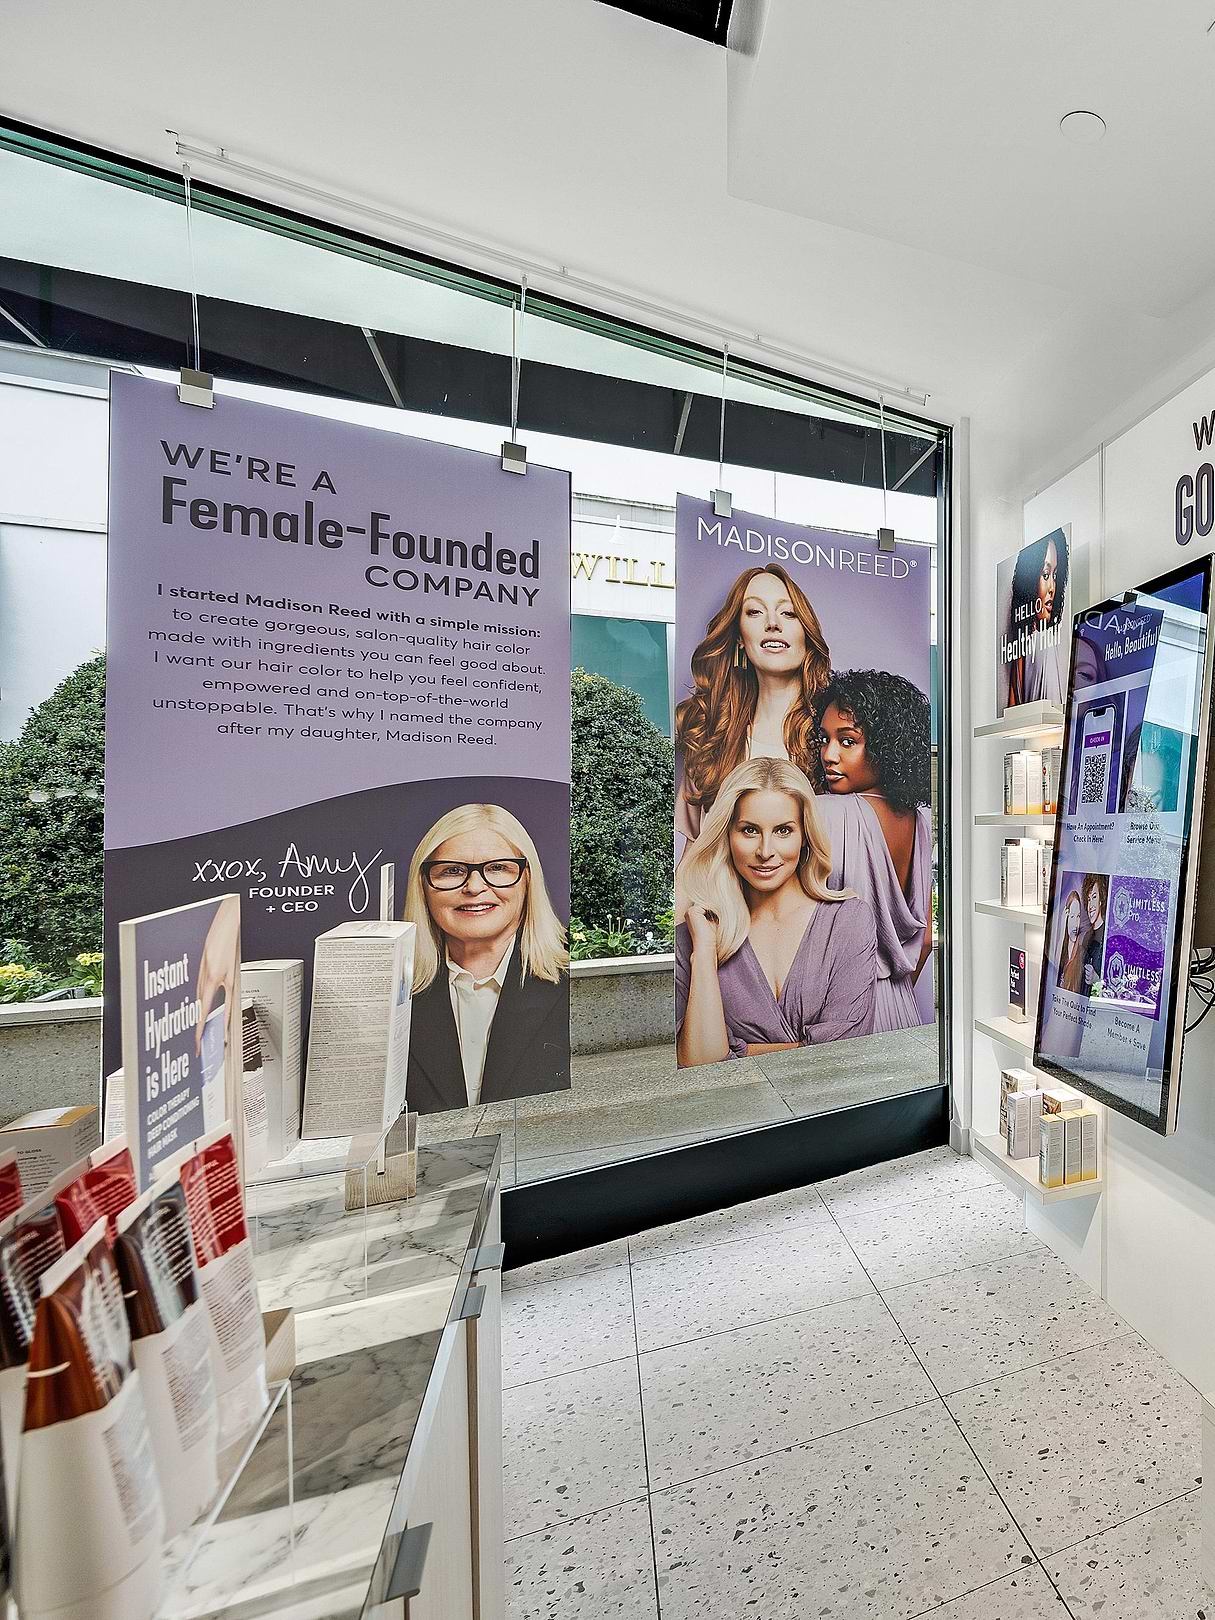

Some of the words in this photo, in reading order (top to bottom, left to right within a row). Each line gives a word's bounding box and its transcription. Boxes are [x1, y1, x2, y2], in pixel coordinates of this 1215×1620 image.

[159, 439, 297, 488] WE'RE
[310, 470, 338, 496] A
[161, 475, 540, 580] Female-Founded
[364, 565, 541, 608] COMPANY
[157, 582, 163, 596] I
[169, 586, 240, 605] started
[245, 593, 323, 614] Madison
[328, 603, 371, 620] Reed
[375, 610, 411, 624] with
[415, 616, 426, 626] a
[429, 616, 480, 632] simple
[483, 623, 541, 639] mission:
[171, 607, 193, 621] to
[198, 613, 259, 628] create
[264, 620, 350, 639] gorgeous,
[354, 628, 459, 651] salon-quality
[462, 637, 492, 652] hair
[494, 642, 531, 656] color
[1014, 597, 1044, 623] HELLO,
[148, 630, 206, 645] made
[211, 635, 252, 649] with
[257, 637, 356, 658] ingredients
[359, 650, 390, 662] you
[394, 653, 424, 665] can
[427, 653, 455, 668] feel
[459, 659, 498, 671] good
[501, 661, 546, 676] about.
[1000, 626, 1036, 665] Healthy
[1039, 617, 1062, 652] Hair
[154, 650, 159, 663] I
[165, 654, 216, 668] want
[220, 659, 253, 671] our
[257, 658, 294, 674] hair
[298, 663, 343, 678] color
[346, 667, 364, 679] to
[369, 667, 404, 685] help
[407, 674, 436, 686] you
[440, 673, 468, 688] feel
[471, 678, 542, 695] confident,
[201, 679, 311, 696] empowered
[316, 686, 350, 699] and
[354, 690, 509, 709] on-top-of-the-world
[152, 698, 278, 715] unstoppable.
[282, 703, 337, 718] That's
[341, 707, 375, 723] why
[380, 709, 384, 721] I
[389, 712, 444, 724] named
[447, 713, 473, 726] the
[476, 717, 543, 732] company
[216, 721, 263, 736] after
[267, 726, 295, 740] my
[299, 725, 381, 743] daughter,
[386, 729, 452, 744] Madison
[457, 732, 498, 746] Reed.
[248, 884, 335, 899] FOUNDER
[265, 905, 277, 914] +
[280, 900, 319, 913] CEO
[1129, 897, 1165, 913] LIMITLESS
[142, 952, 191, 1002] Instant
[143, 996, 204, 1060] Hydration
[144, 1065, 161, 1103] is
[160, 1050, 191, 1093] Here
